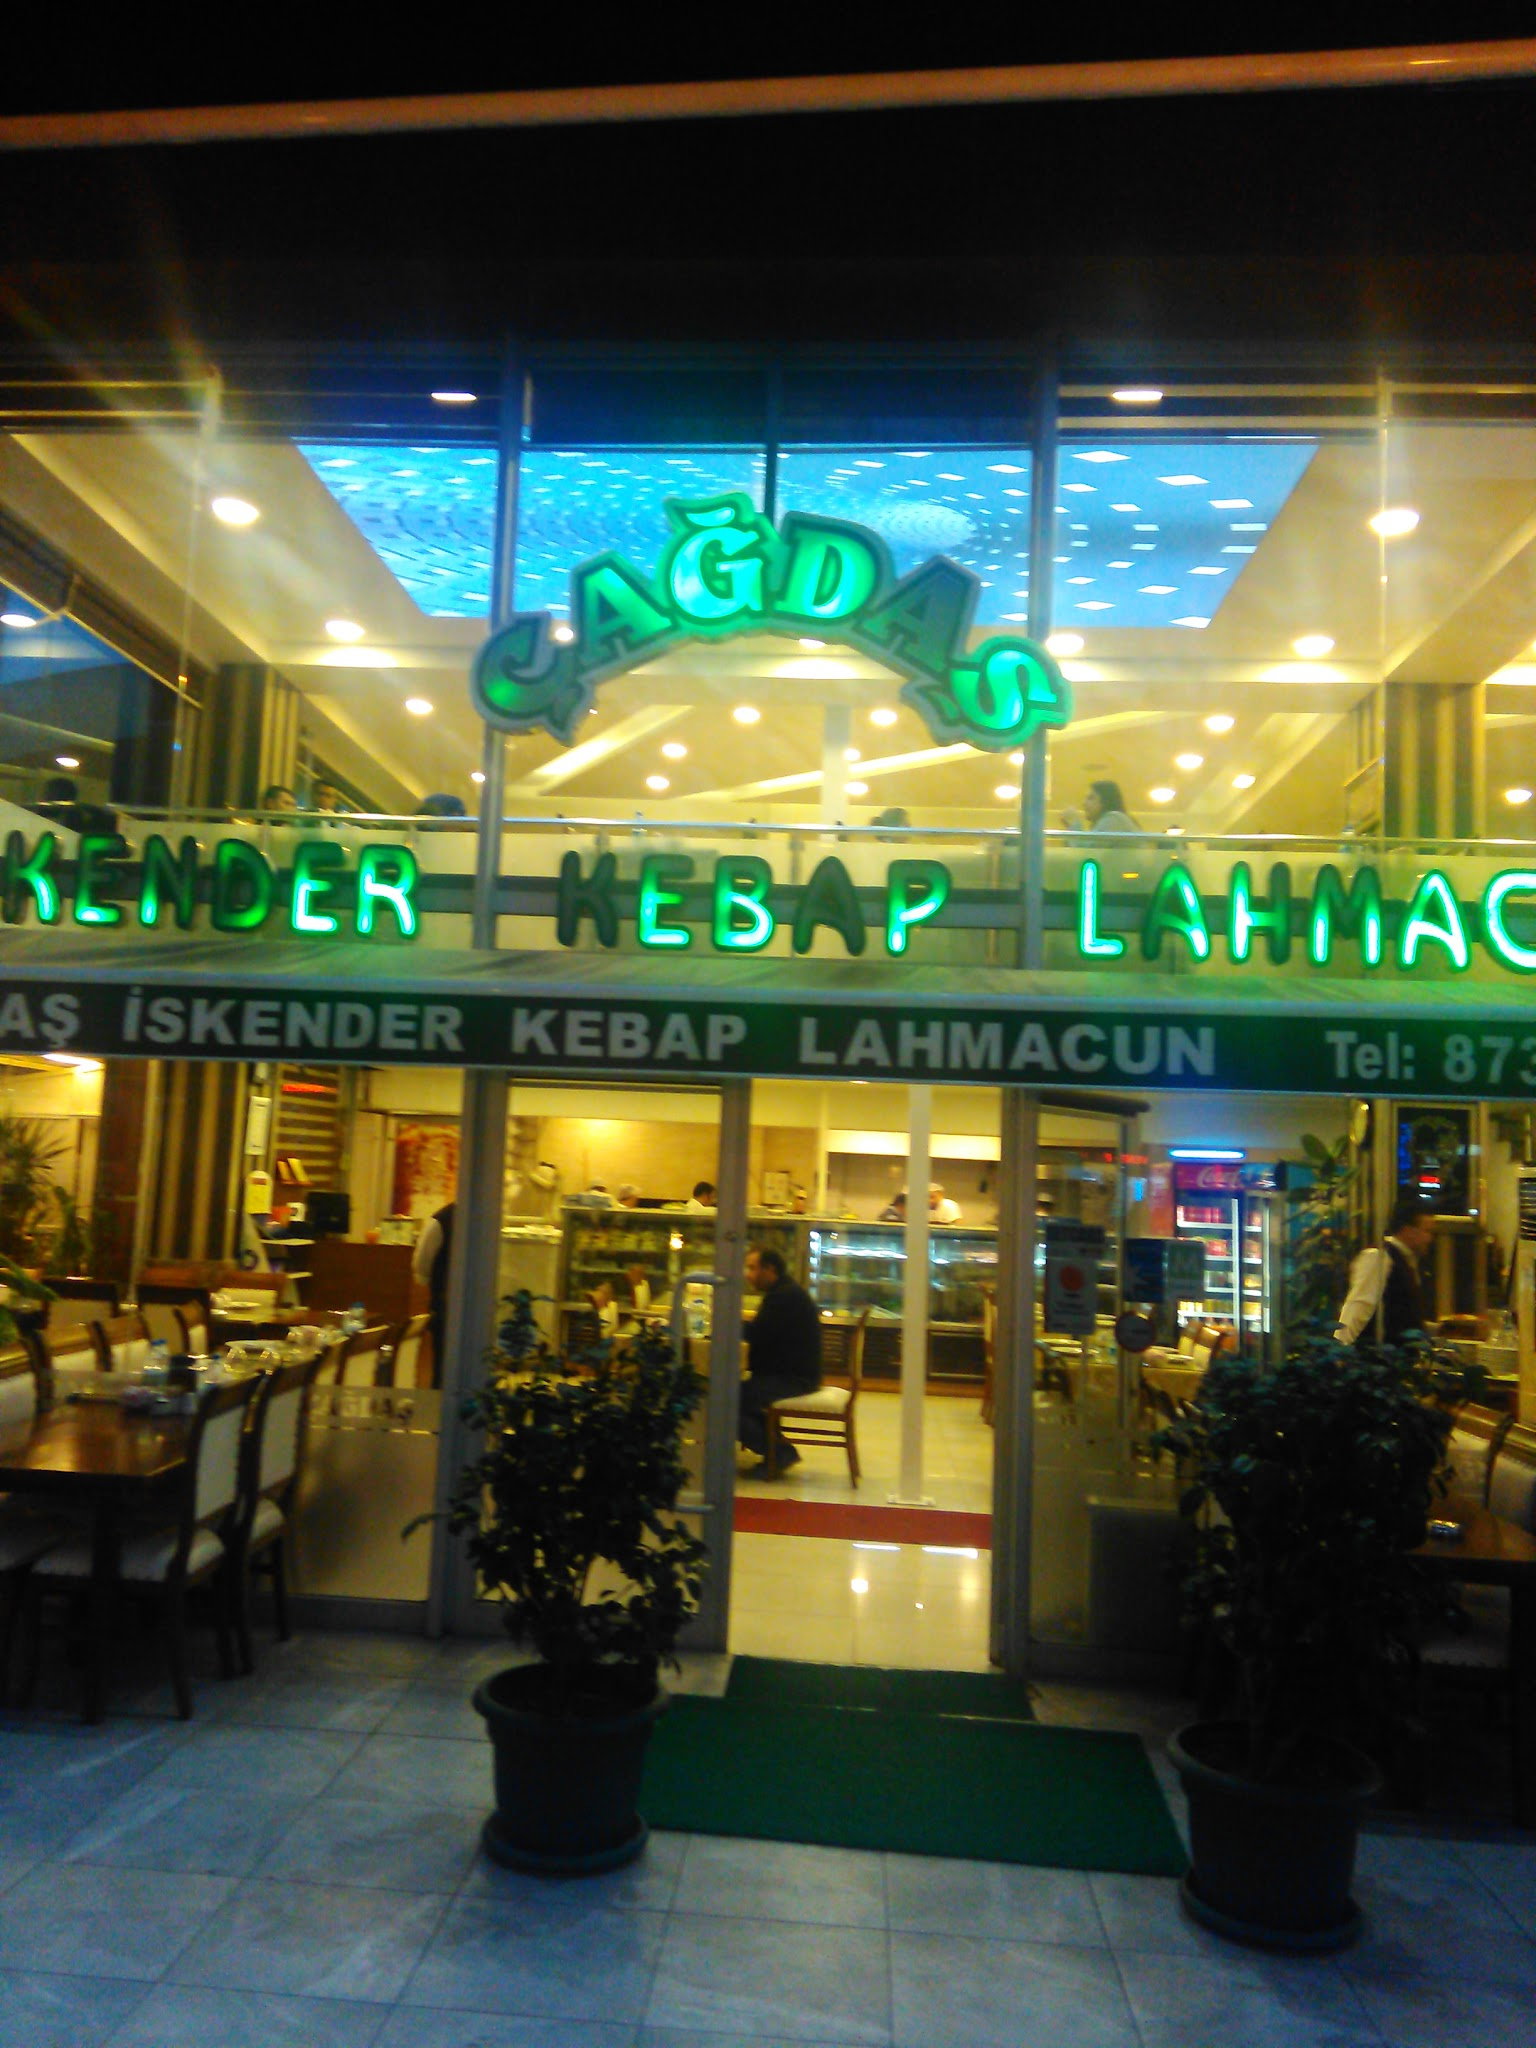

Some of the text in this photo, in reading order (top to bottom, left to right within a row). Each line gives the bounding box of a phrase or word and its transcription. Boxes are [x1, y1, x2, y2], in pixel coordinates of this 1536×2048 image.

[3, 830, 423, 939] KENDER
[556, 850, 952, 958] KEBAP
[122, 985, 464, 1053] İSKENDER
[510, 1008, 748, 1062] KEBAP
[799, 1016, 1216, 1077] LAHMACUN
[1325, 1031, 1416, 1080] Tel:
